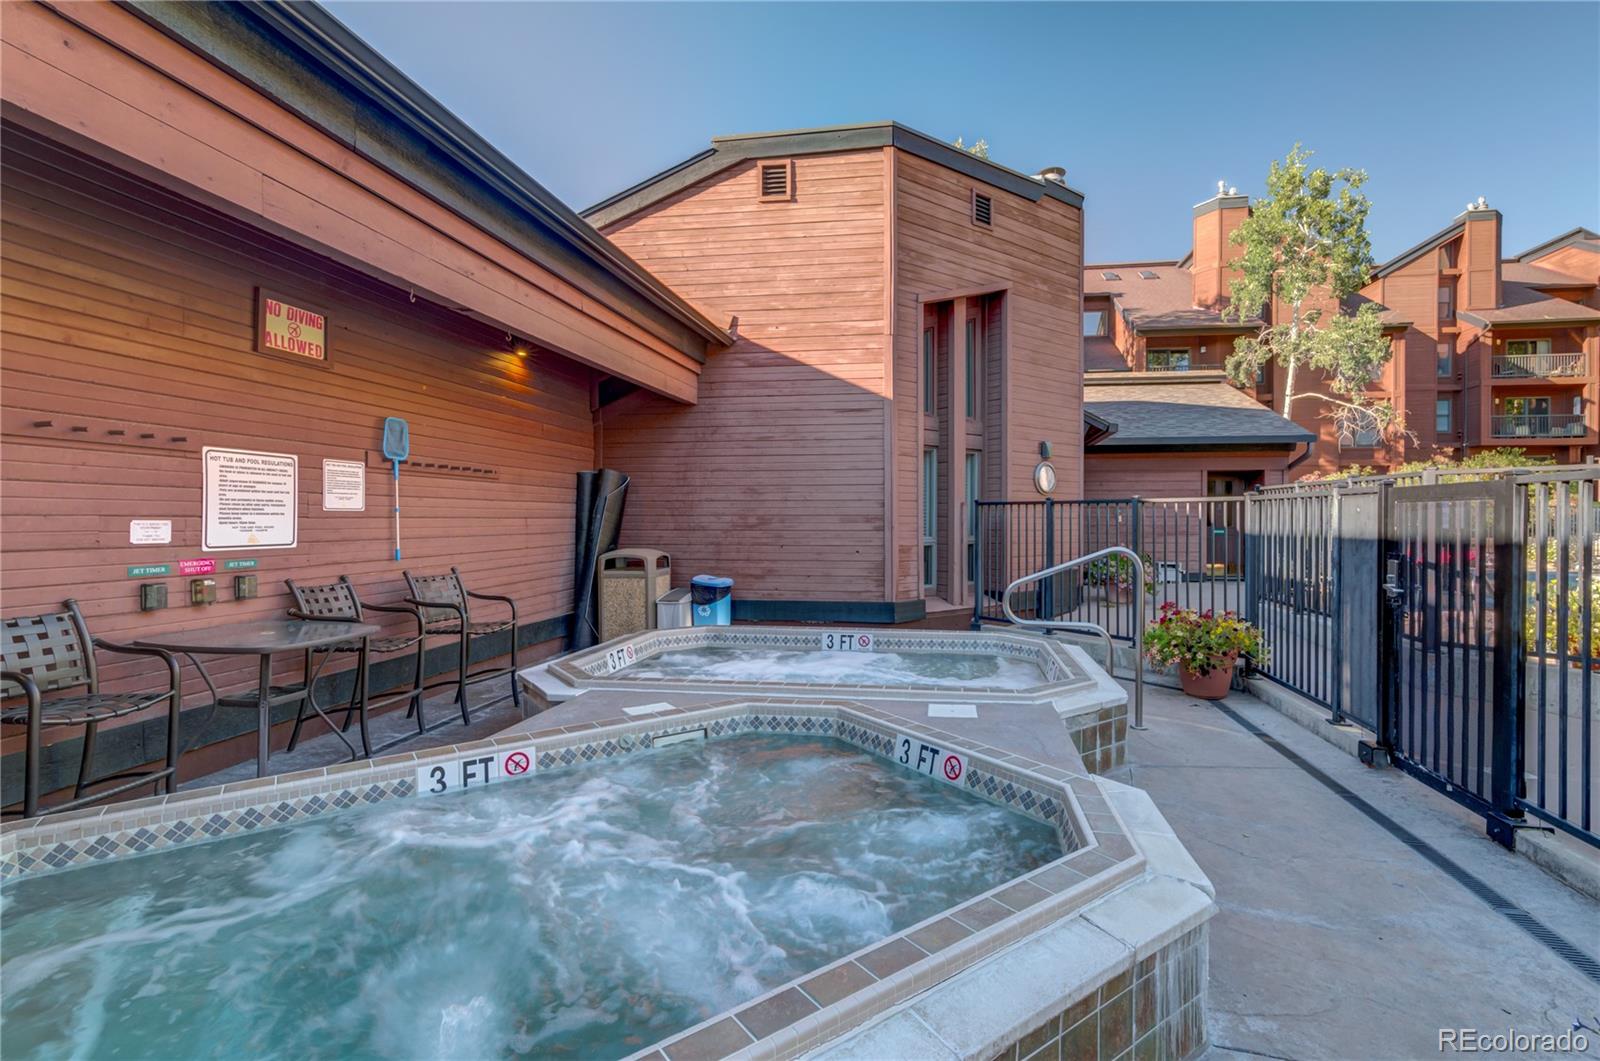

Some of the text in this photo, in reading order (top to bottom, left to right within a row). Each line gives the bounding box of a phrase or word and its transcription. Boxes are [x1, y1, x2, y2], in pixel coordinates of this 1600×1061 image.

[265, 300, 322, 330] NO DIVING
[265, 331, 322, 358] ALLOWED
[826, 634, 855, 650] 3 FT
[609, 648, 626, 670] 3 FT
[900, 738, 940, 775] 3 FT
[429, 755, 495, 794] 3 FT
